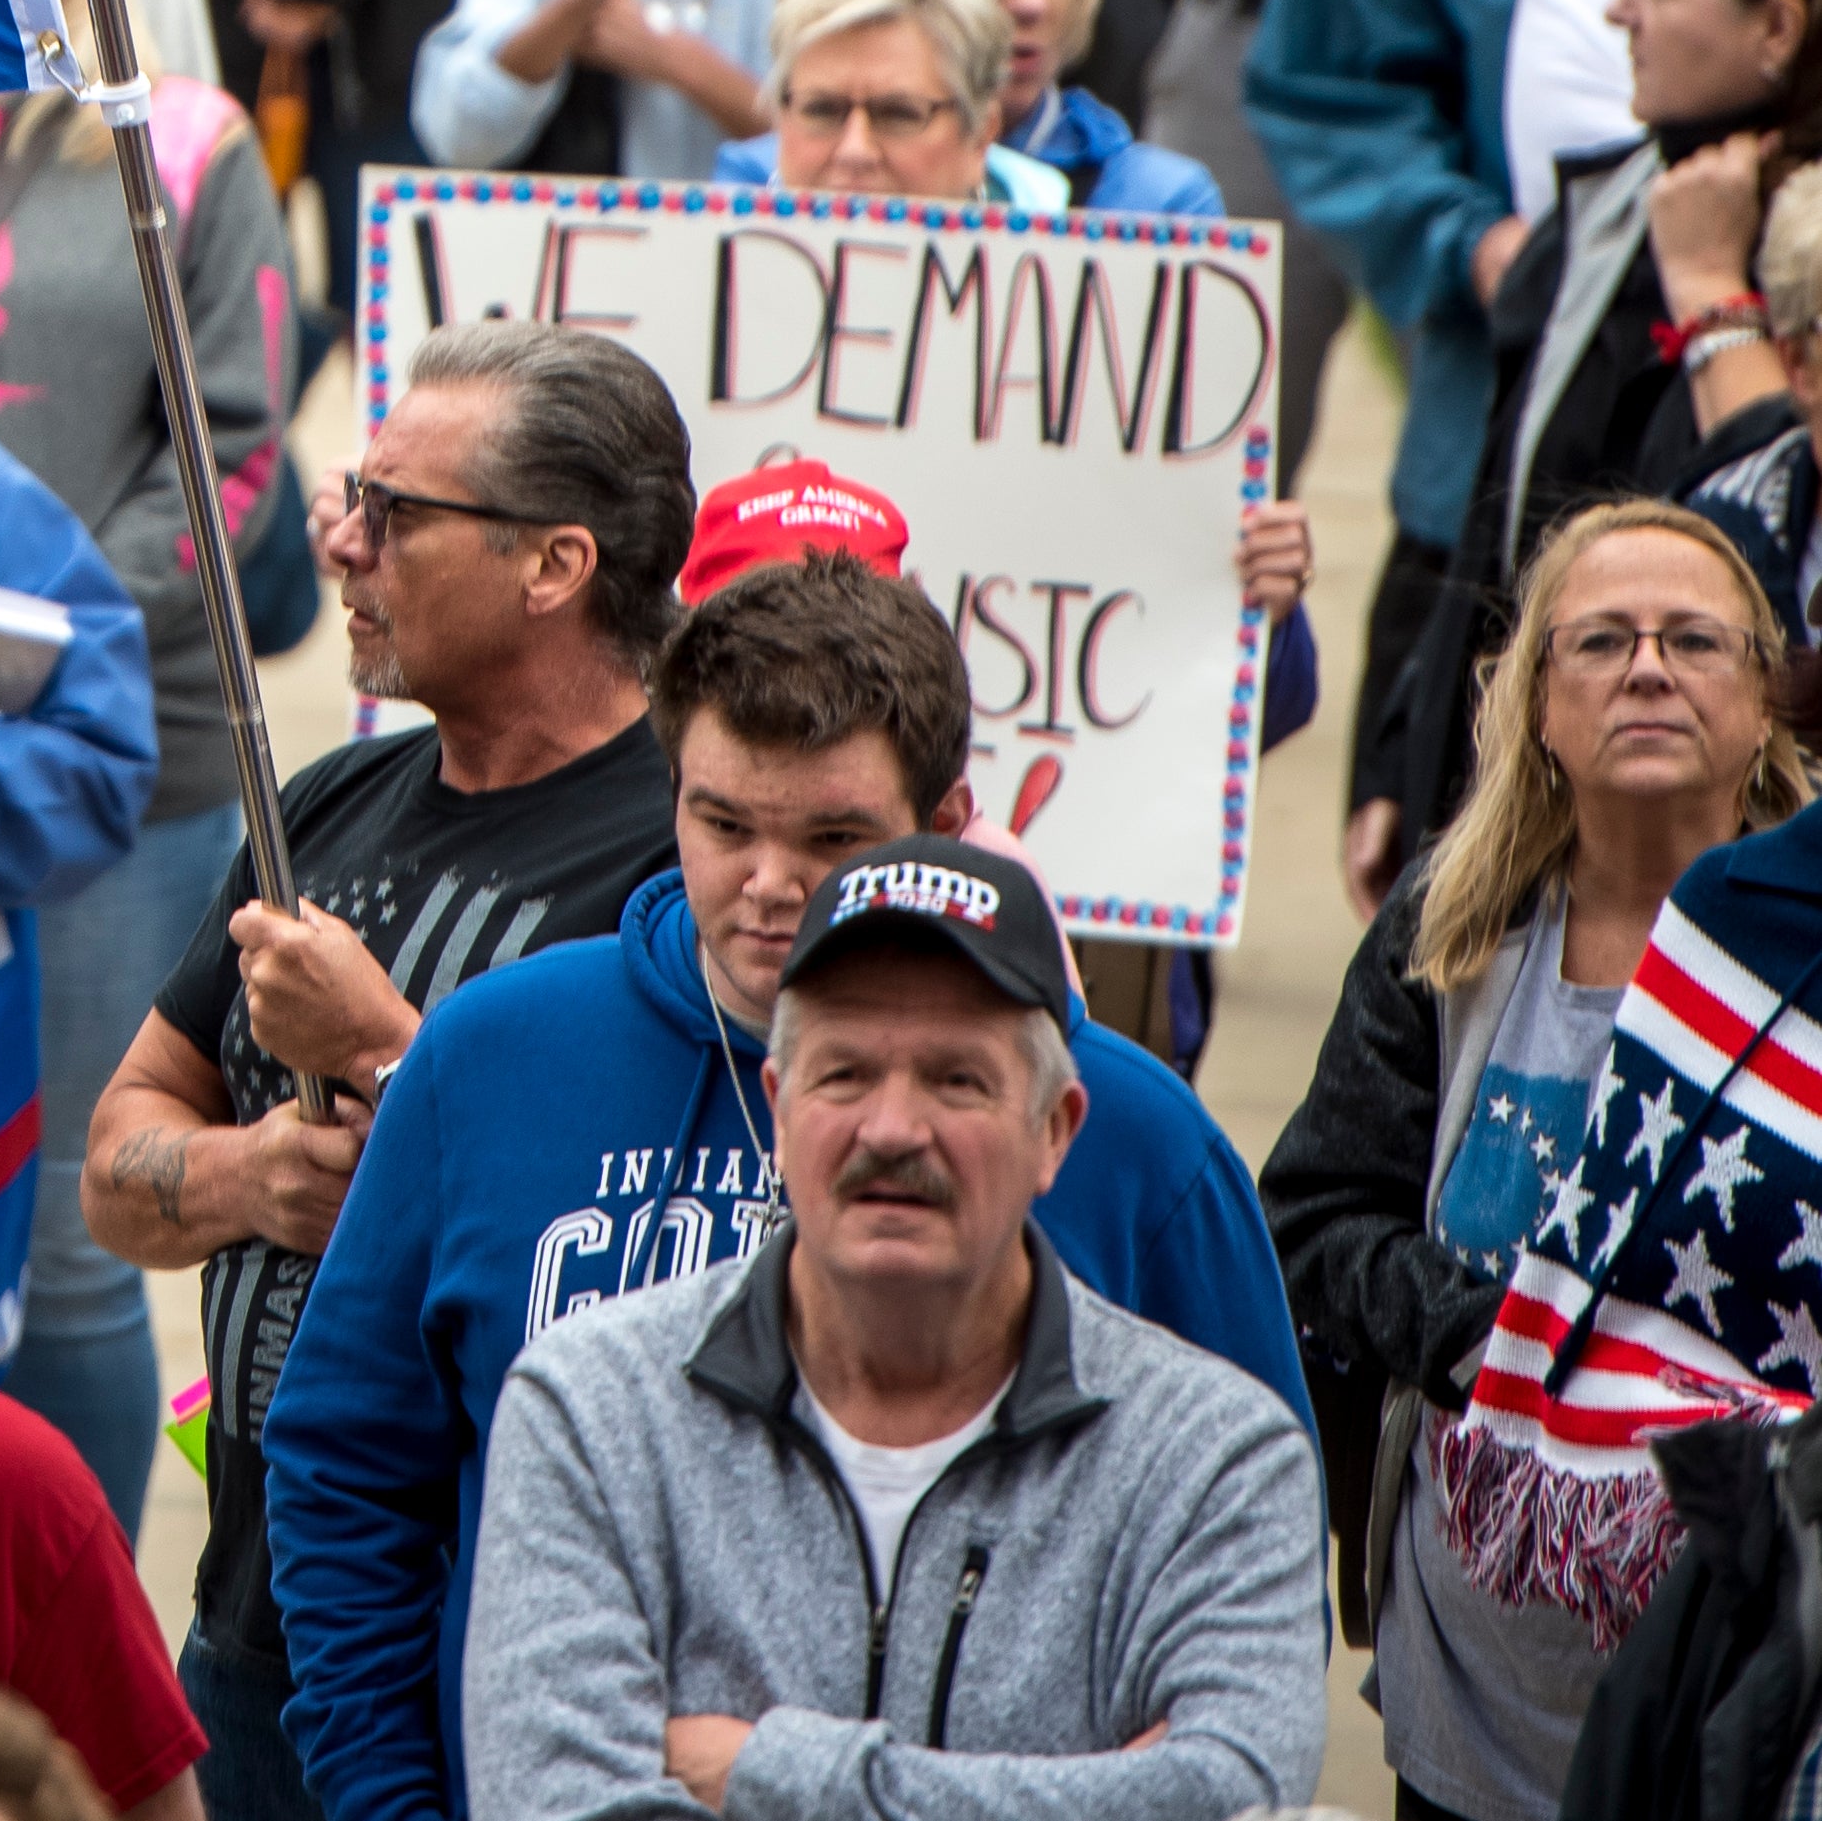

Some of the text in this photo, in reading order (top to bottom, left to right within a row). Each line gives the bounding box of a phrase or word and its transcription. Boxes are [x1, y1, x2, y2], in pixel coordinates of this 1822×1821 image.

[709, 228, 1274, 460] DEMAND
[737, 483, 889, 529] KEEP AMERICA
[838, 860, 1001, 924] Trump
